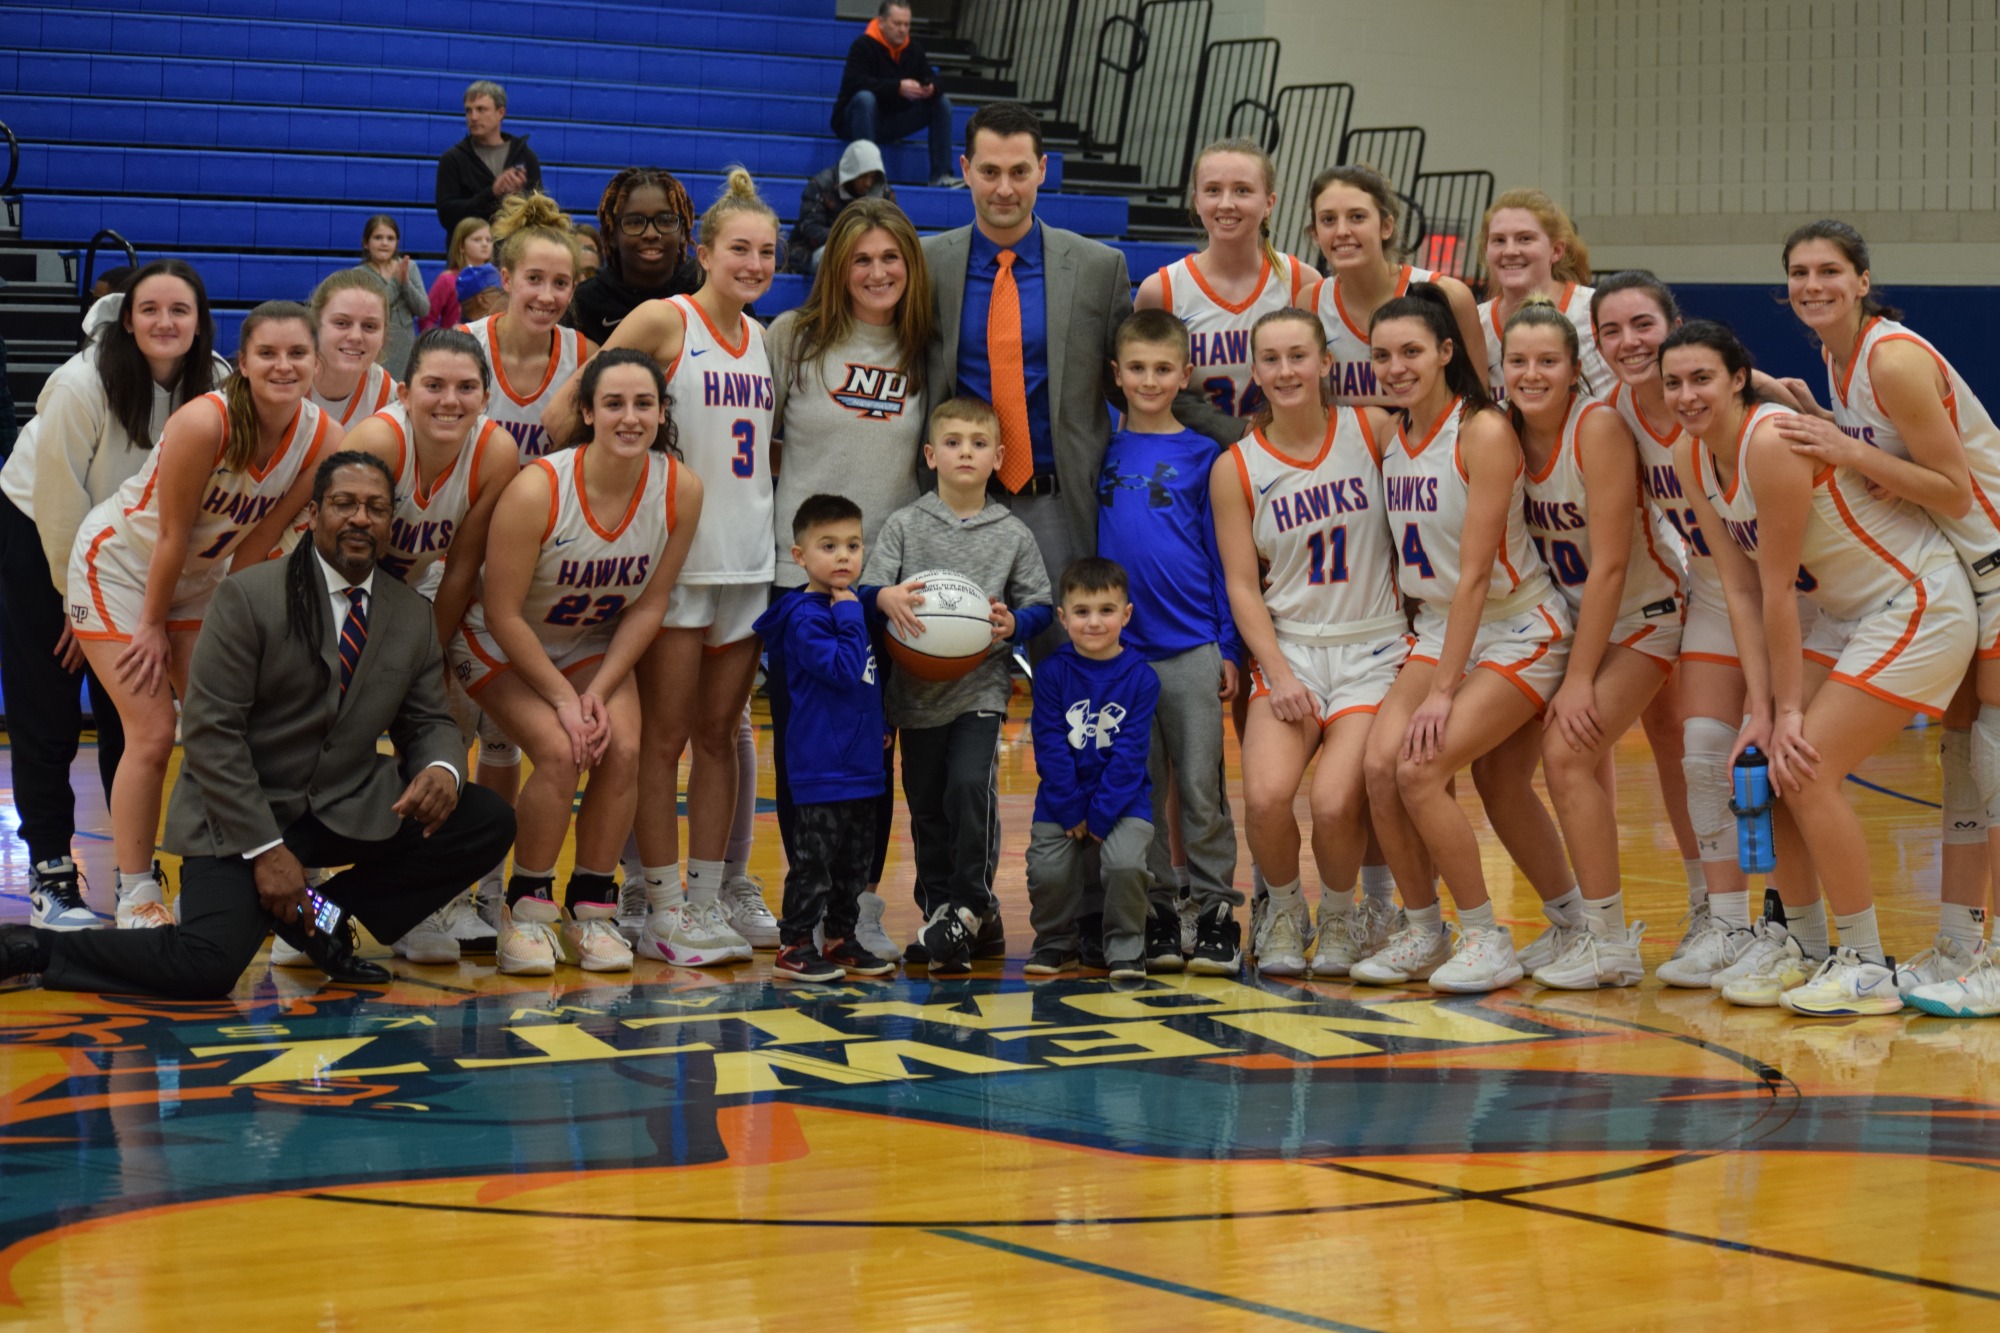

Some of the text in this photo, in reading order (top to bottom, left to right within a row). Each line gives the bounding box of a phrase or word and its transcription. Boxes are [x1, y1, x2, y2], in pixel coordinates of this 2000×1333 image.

[1190, 329, 1249, 367] HAW
[703, 370, 774, 412] HAWKS
[1329, 361, 1388, 397] HAW
[732, 418, 755, 479] 3
[1386, 476, 1438, 512] HAWKS
[1643, 464, 1684, 499] HAW
[202, 485, 285, 526] HAWK
[1271, 477, 1369, 533] HAWKS
[197, 529, 240, 559] 1
[1307, 525, 1349, 586] 11
[1401, 522, 1437, 580] 4
[556, 554, 650, 589] HAWKS
[543, 593, 627, 627] 23
[189, 973, 1320, 1085] PALTZ
[713, 999, 1556, 1096] NEW
